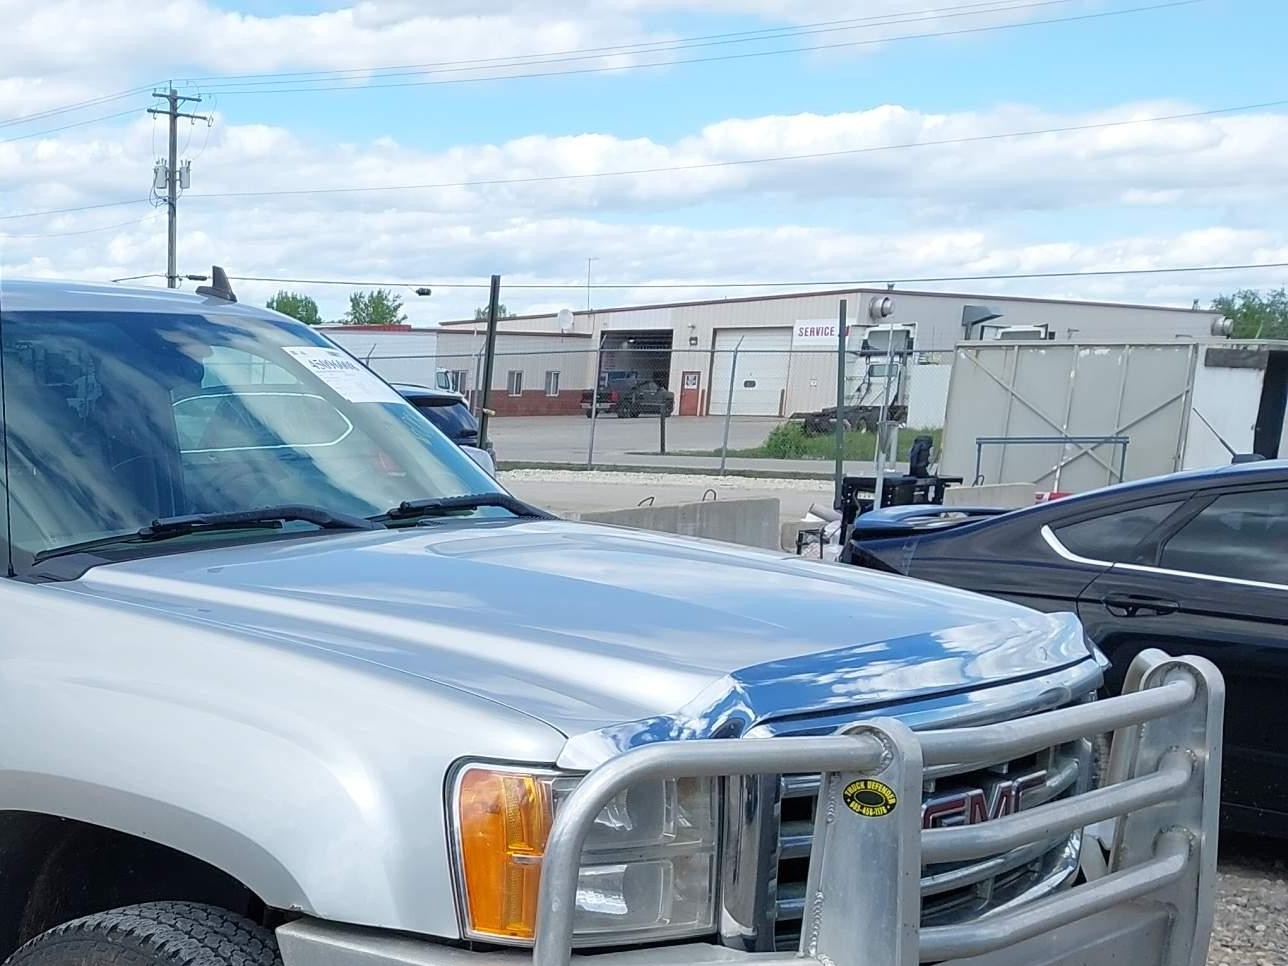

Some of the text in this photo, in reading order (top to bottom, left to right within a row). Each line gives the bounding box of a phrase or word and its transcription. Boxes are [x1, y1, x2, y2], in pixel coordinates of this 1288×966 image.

[798, 326, 835, 337] SERVICE
[844, 780, 896, 805] TRUCK DEFENDER
